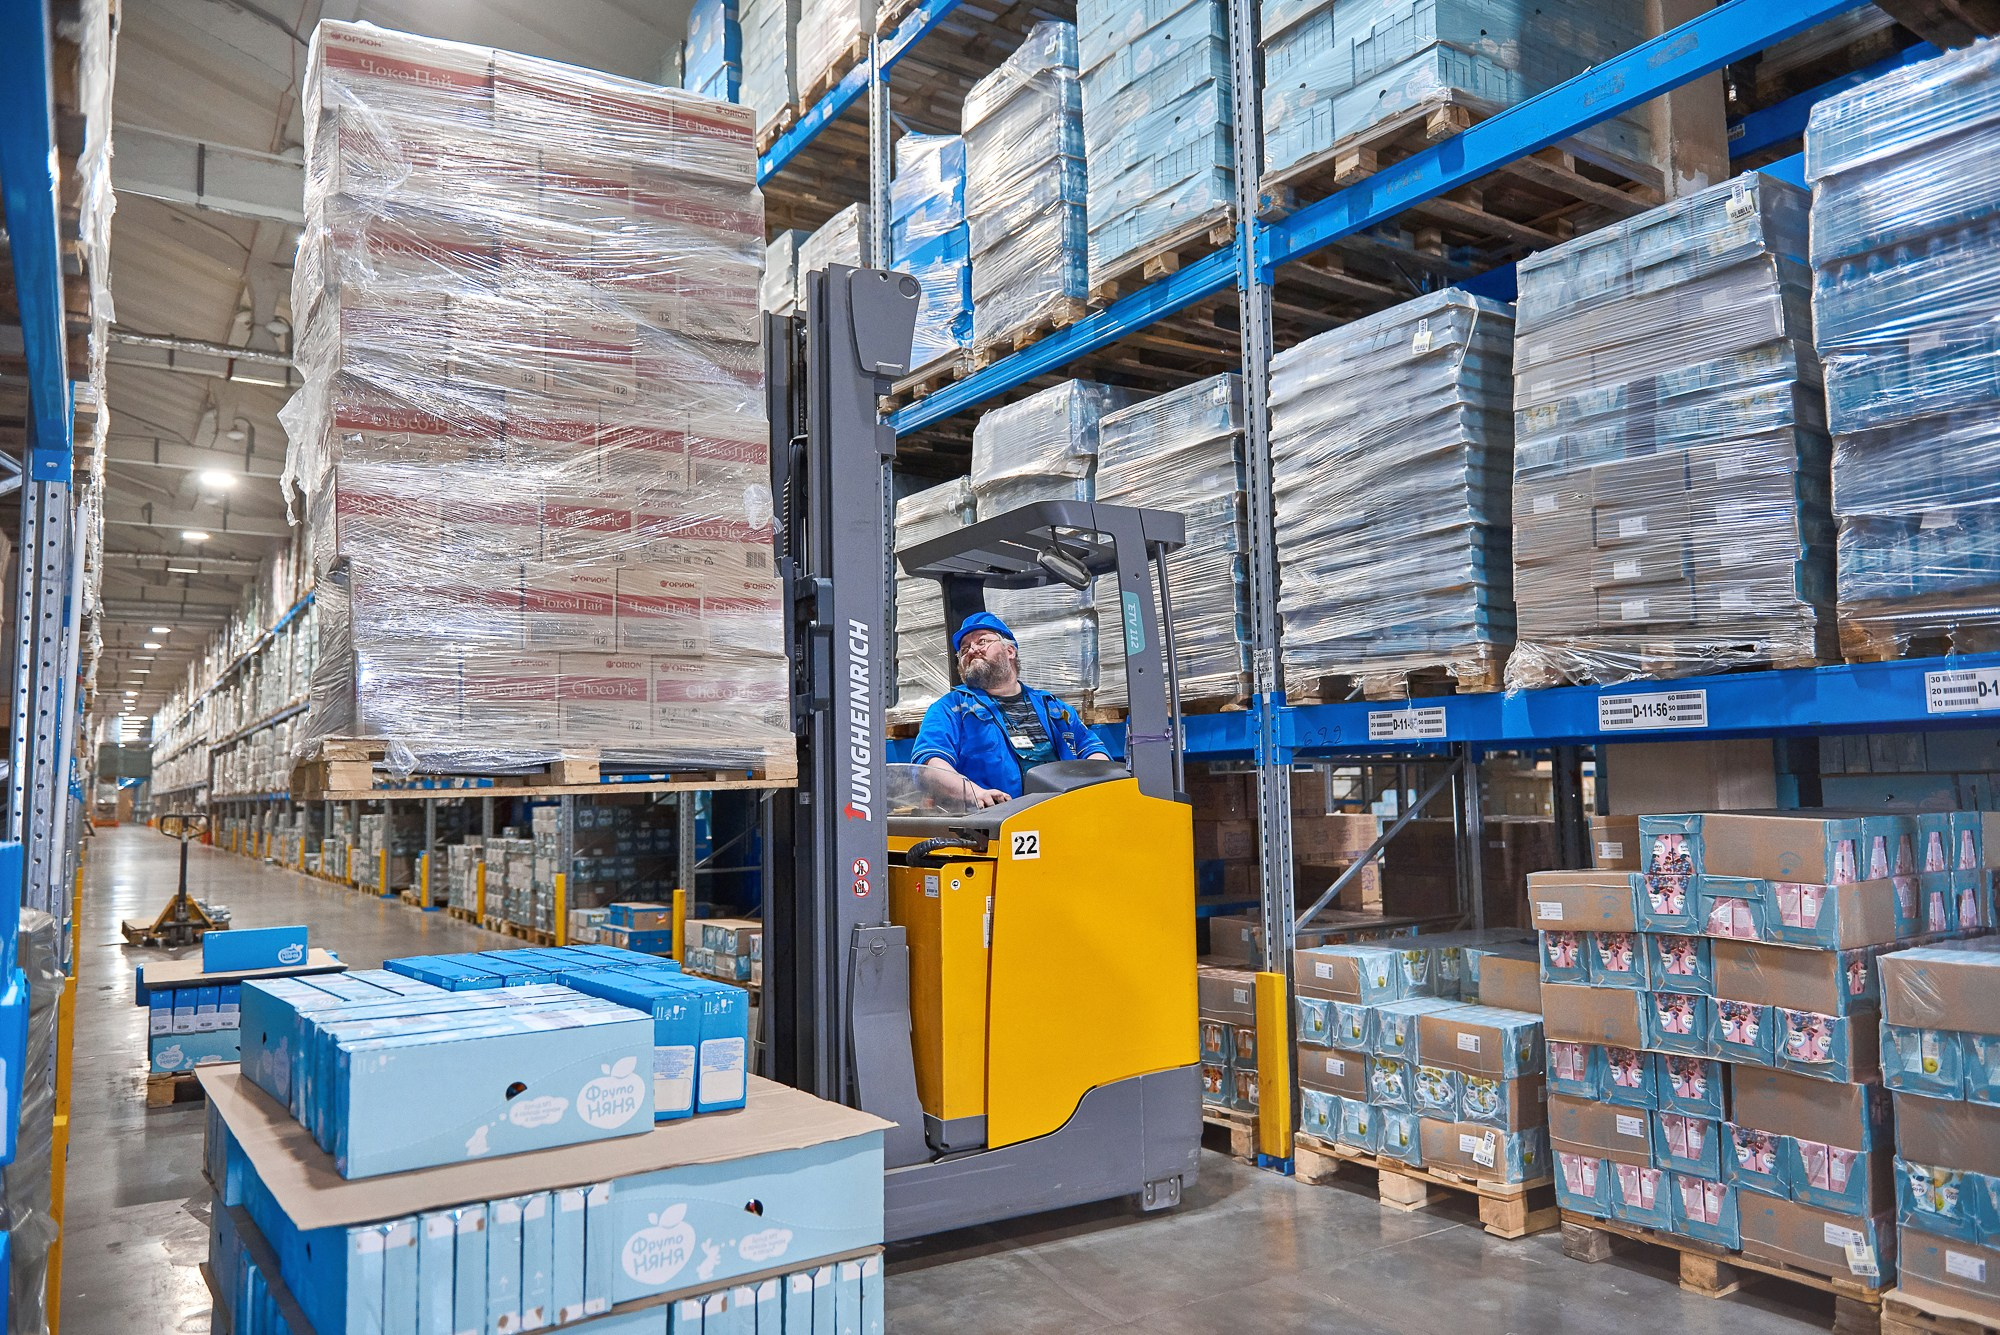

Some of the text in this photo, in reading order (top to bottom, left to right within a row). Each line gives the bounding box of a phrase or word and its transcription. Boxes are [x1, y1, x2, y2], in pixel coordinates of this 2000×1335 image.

[659, 313, 671, 322] 12
[522, 373, 534, 383] 12
[615, 386, 626, 395] 12
[614, 552, 626, 562] 12
[579, 575, 608, 585] ОРИОН
[668, 581, 696, 590] ОРИОН
[1127, 602, 1140, 650] ETV 112
[596, 636, 607, 646] 12
[684, 639, 695, 649] 12
[614, 661, 643, 670] ORION
[1931, 676, 1941, 684] 30
[1632, 702, 1668, 718] D-11-56
[849, 618, 872, 822] JUNGHEINRICH
[630, 721, 642, 730] 12
[1014, 834, 1038, 855] 22
[585, 1083, 635, 1102] Фруто
[587, 1096, 636, 1121] НЯНЯ
[631, 1233, 684, 1256] Фруто
[632, 1248, 685, 1276] НЯНЯ
